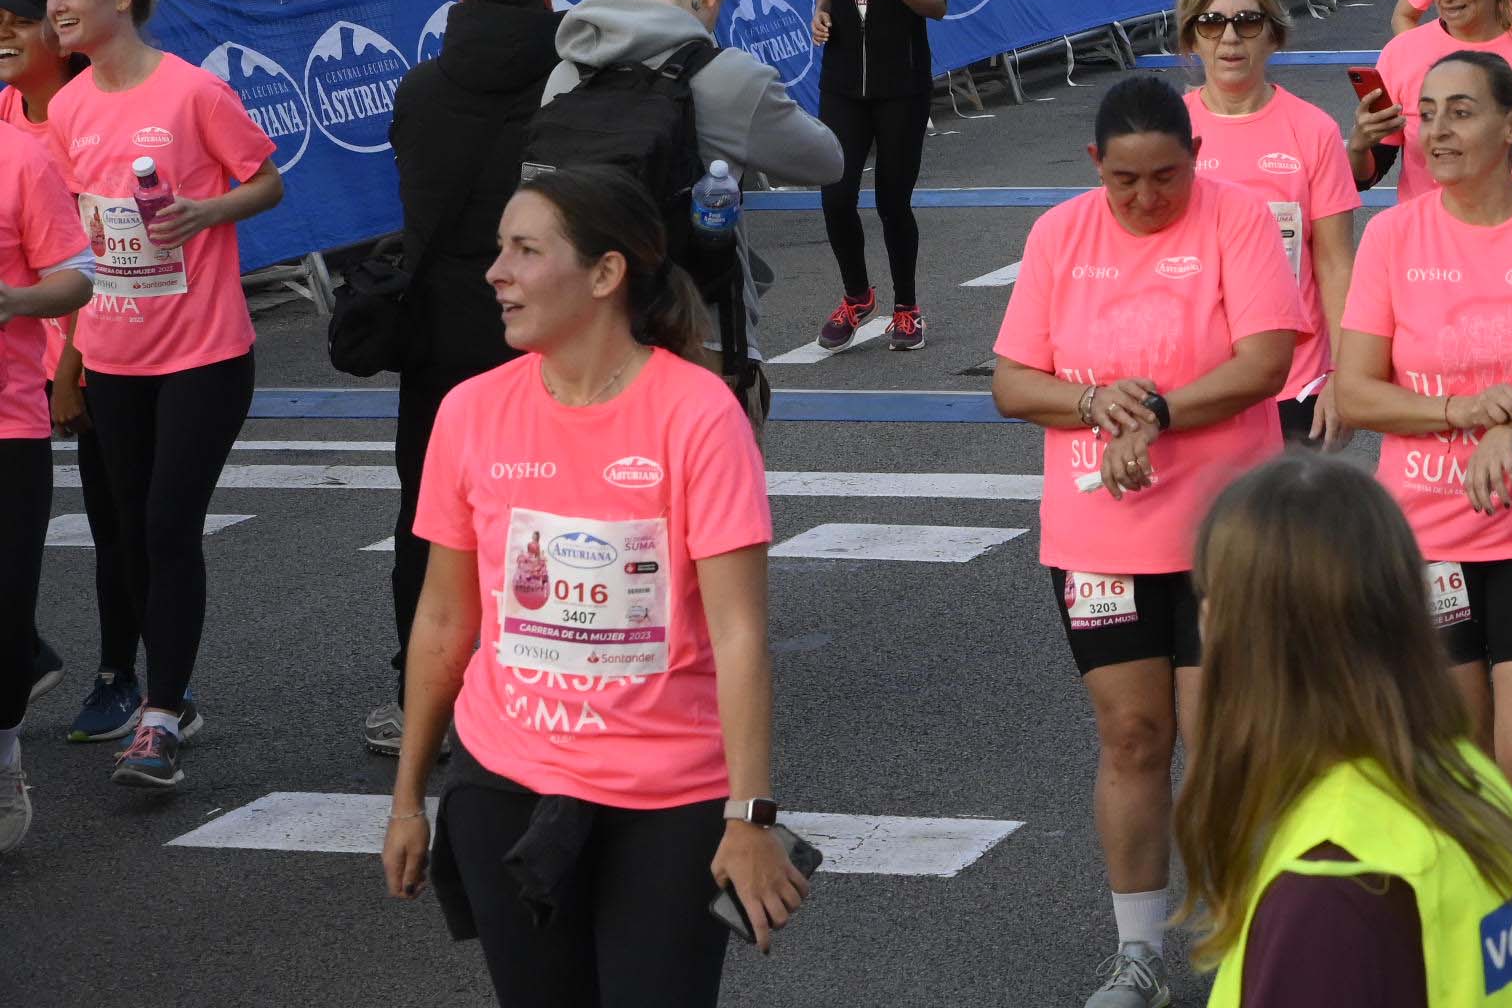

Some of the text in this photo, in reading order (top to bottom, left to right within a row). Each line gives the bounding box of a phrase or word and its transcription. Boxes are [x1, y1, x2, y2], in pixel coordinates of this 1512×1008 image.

[326, 58, 400, 85] CENTRAL LECHERA
[317, 74, 404, 127] ASTURIAN
[250, 98, 305, 139] RIANA
[107, 237, 142, 252] 016
[111, 255, 138, 265] 31317
[116, 267, 123, 276] DE
[124, 267, 132, 276] LA
[133, 266, 156, 276] MUJER
[1407, 268, 1462, 284] OYSHO
[142, 278, 178, 290] Santander
[1406, 371, 1444, 397] TU
[1071, 439, 1099, 470] SU
[490, 461, 557, 480] OYSHO
[608, 468, 661, 482] ASTURIANA
[1404, 450, 1469, 485] SUM
[553, 542, 612, 563] ASTURIANA
[624, 541, 656, 552] SUMA
[554, 579, 609, 604] 016
[1079, 580, 1126, 599] 016
[1434, 572, 1463, 593] 16
[562, 609, 597, 625] 3407
[1089, 602, 1118, 614] 3203
[1444, 608, 1471, 622] LA MUJ
[1091, 618, 1102, 627] DE
[519, 623, 652, 641] CARRERA DE LA MUJER 2023
[513, 642, 656, 664] OYSHO Santander
